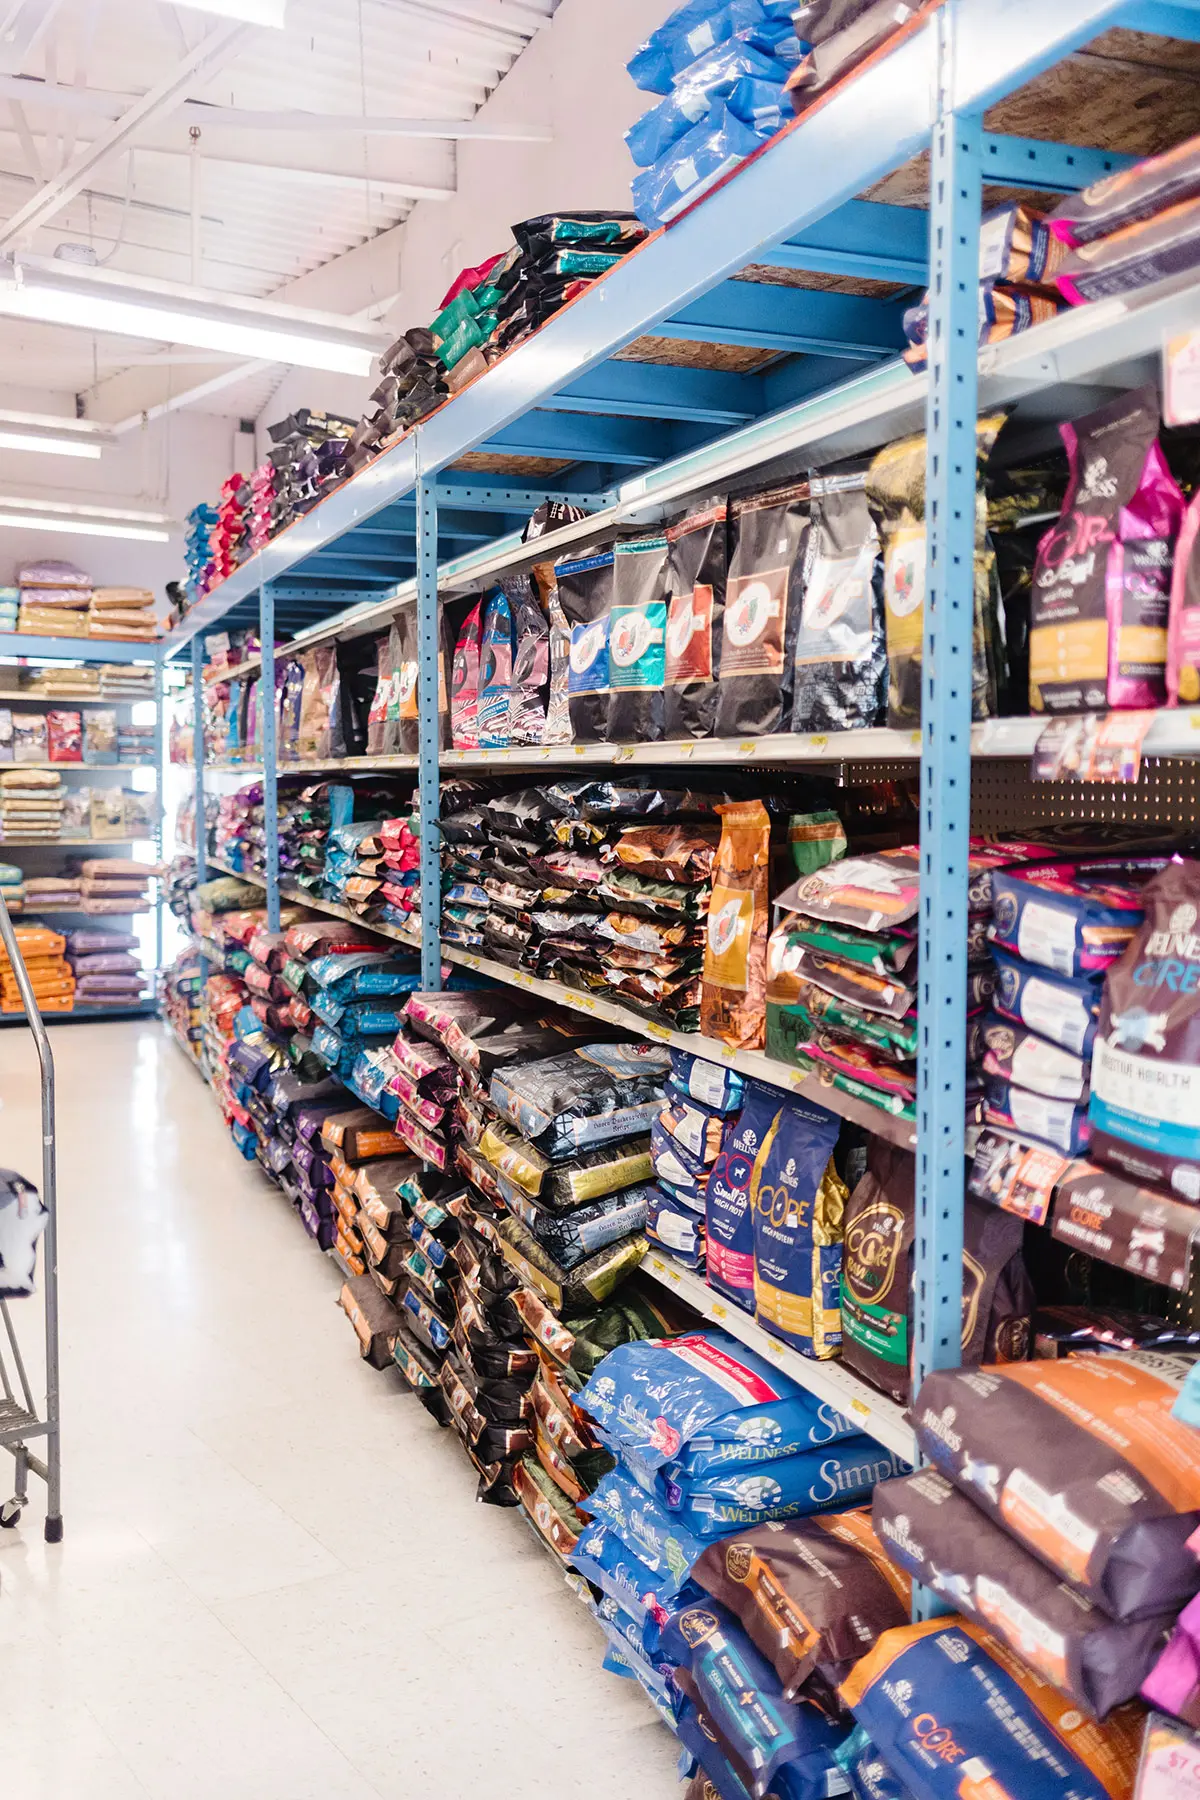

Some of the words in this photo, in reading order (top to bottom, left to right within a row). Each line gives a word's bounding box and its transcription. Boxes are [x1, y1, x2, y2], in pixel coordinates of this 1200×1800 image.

[713, 1180, 740, 1202] Small
[714, 1197, 729, 1210] HIGH
[757, 1185, 811, 1228] CORE
[1070, 1206, 1104, 1231] CORE
[848, 1228, 893, 1268] CORE
[922, 1408, 963, 1453] WELLNESS
[719, 1441, 801, 1461] WELLNESS
[719, 1501, 801, 1524] WELLNESS
[881, 1517, 925, 1563] WELLNESS
[881, 1680, 912, 1718] WELLNESS
[913, 1713, 966, 1764] CORE
